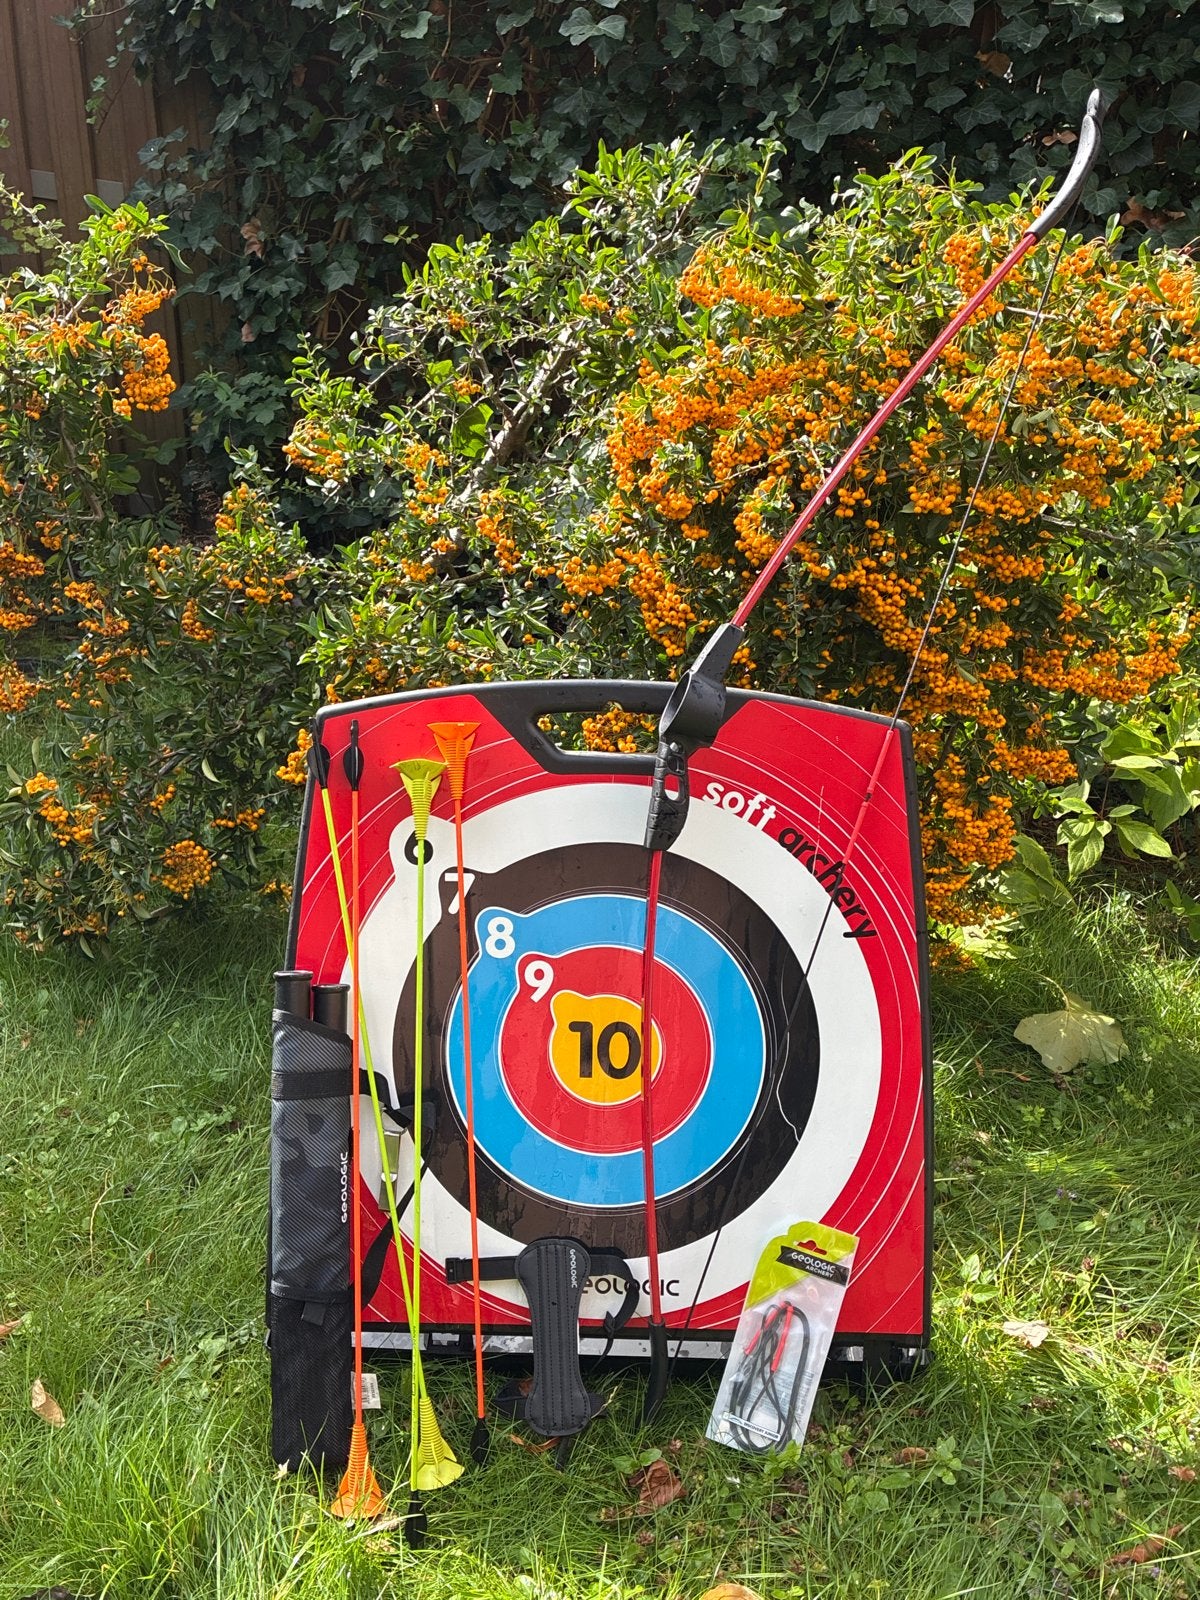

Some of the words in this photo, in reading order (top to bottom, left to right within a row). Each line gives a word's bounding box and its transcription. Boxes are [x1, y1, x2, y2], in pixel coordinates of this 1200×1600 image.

[702, 782, 776, 831] soft
[777, 827, 877, 938] archery
[444, 872, 475, 914] 7
[485, 916, 515, 958] 8
[524, 960, 554, 1002] 9
[568, 1020, 641, 1080] 10
[805, 1265, 834, 1278] ARCHERY
